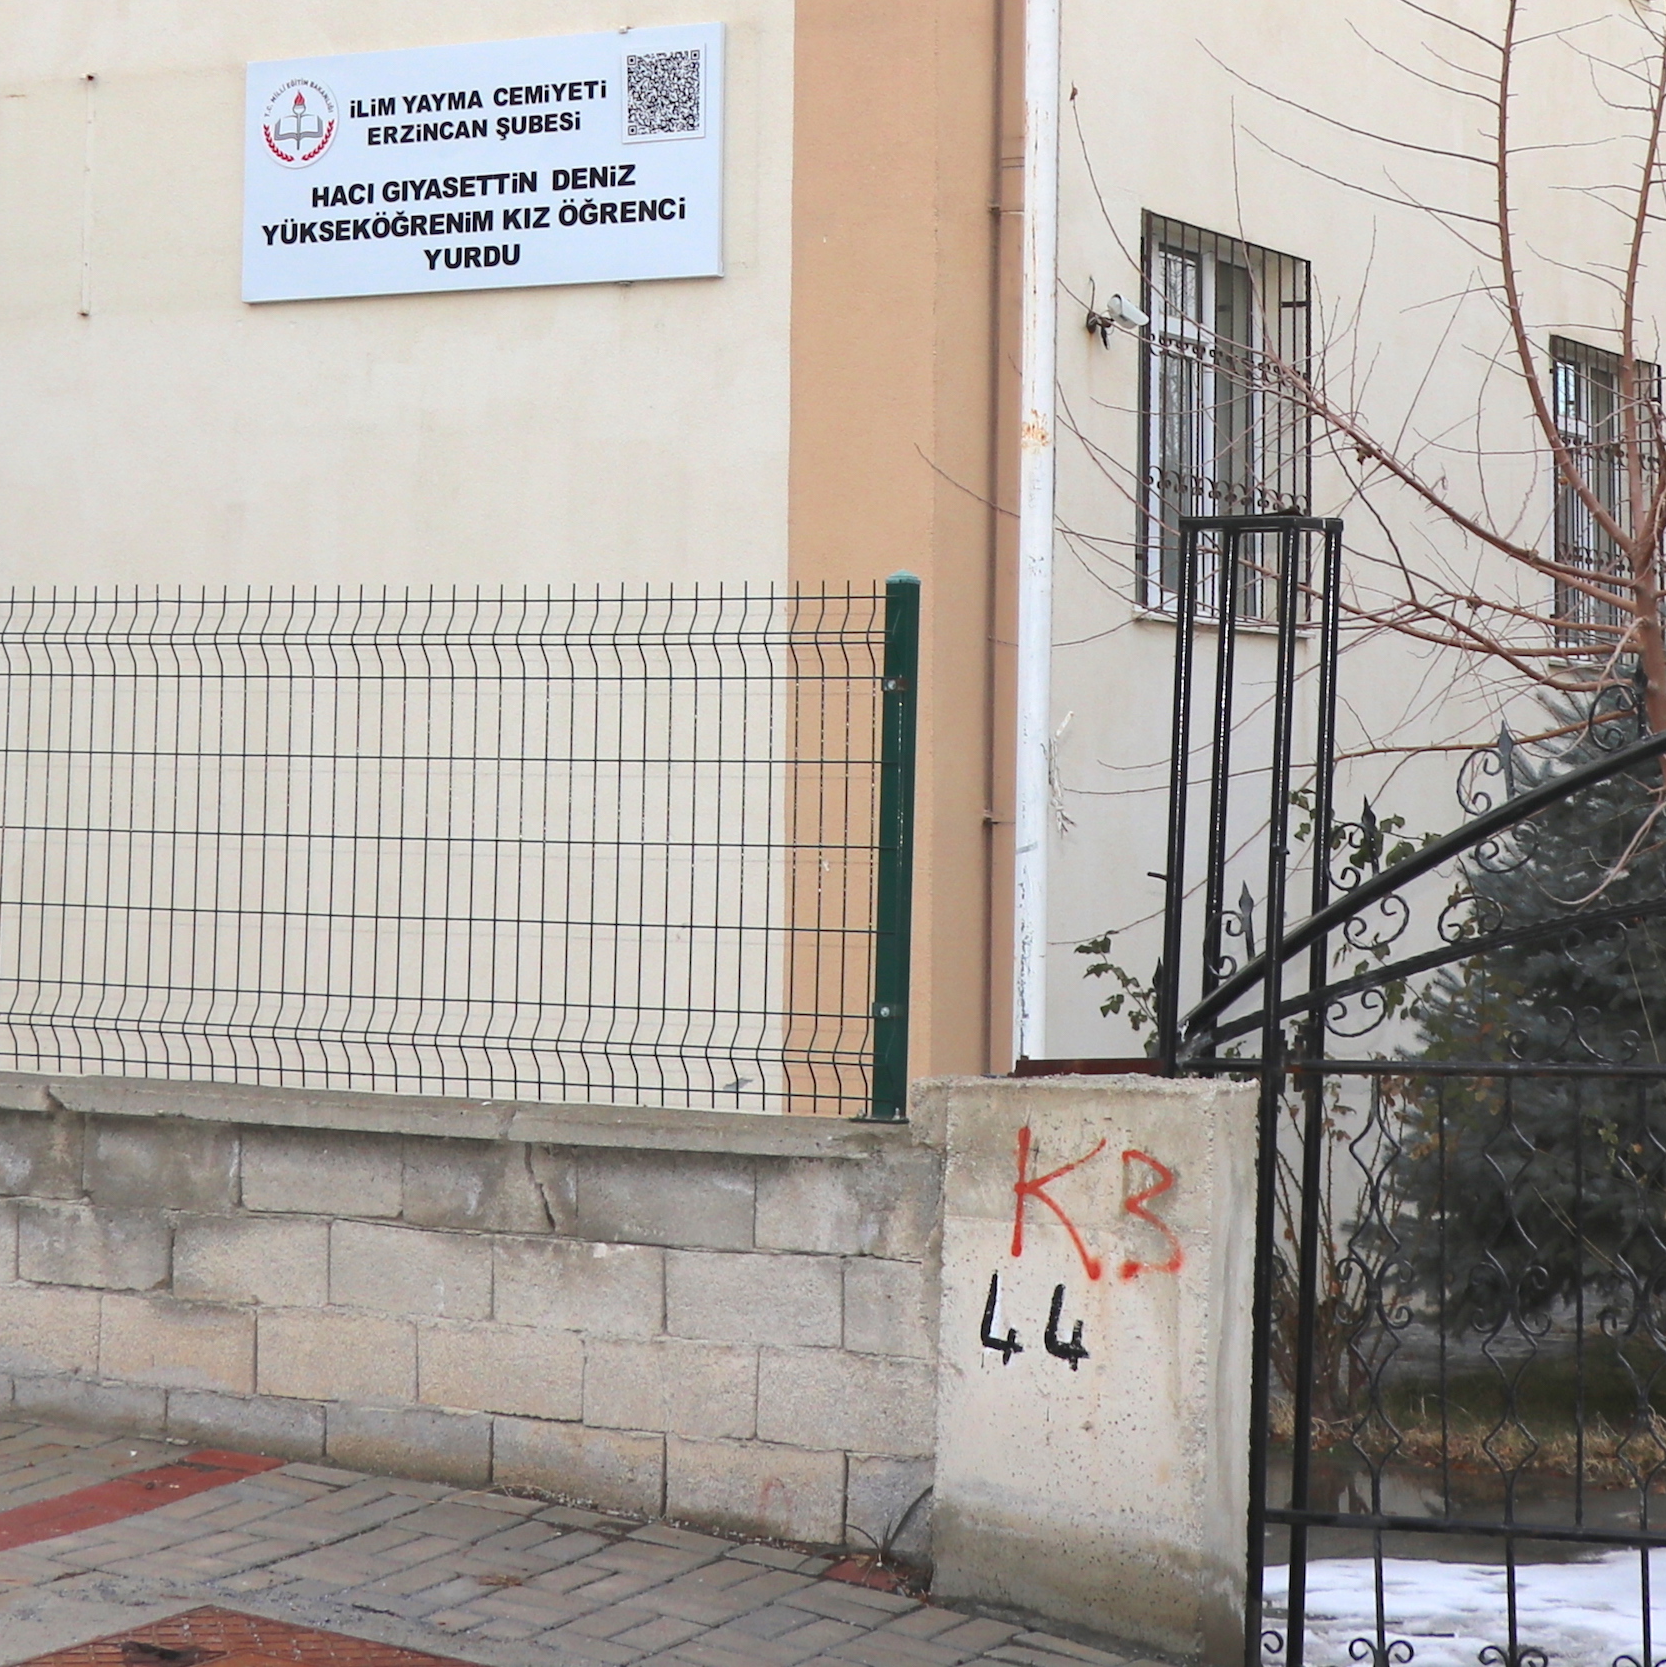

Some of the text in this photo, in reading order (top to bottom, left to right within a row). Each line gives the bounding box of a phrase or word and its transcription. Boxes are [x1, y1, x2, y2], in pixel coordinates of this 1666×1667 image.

[402, 90, 484, 114] YAYMA
[312, 183, 374, 208] HACI
[502, 206, 551, 231] KIZ
[423, 243, 521, 271] YURDU
[980, 1269, 1090, 1372] 44
